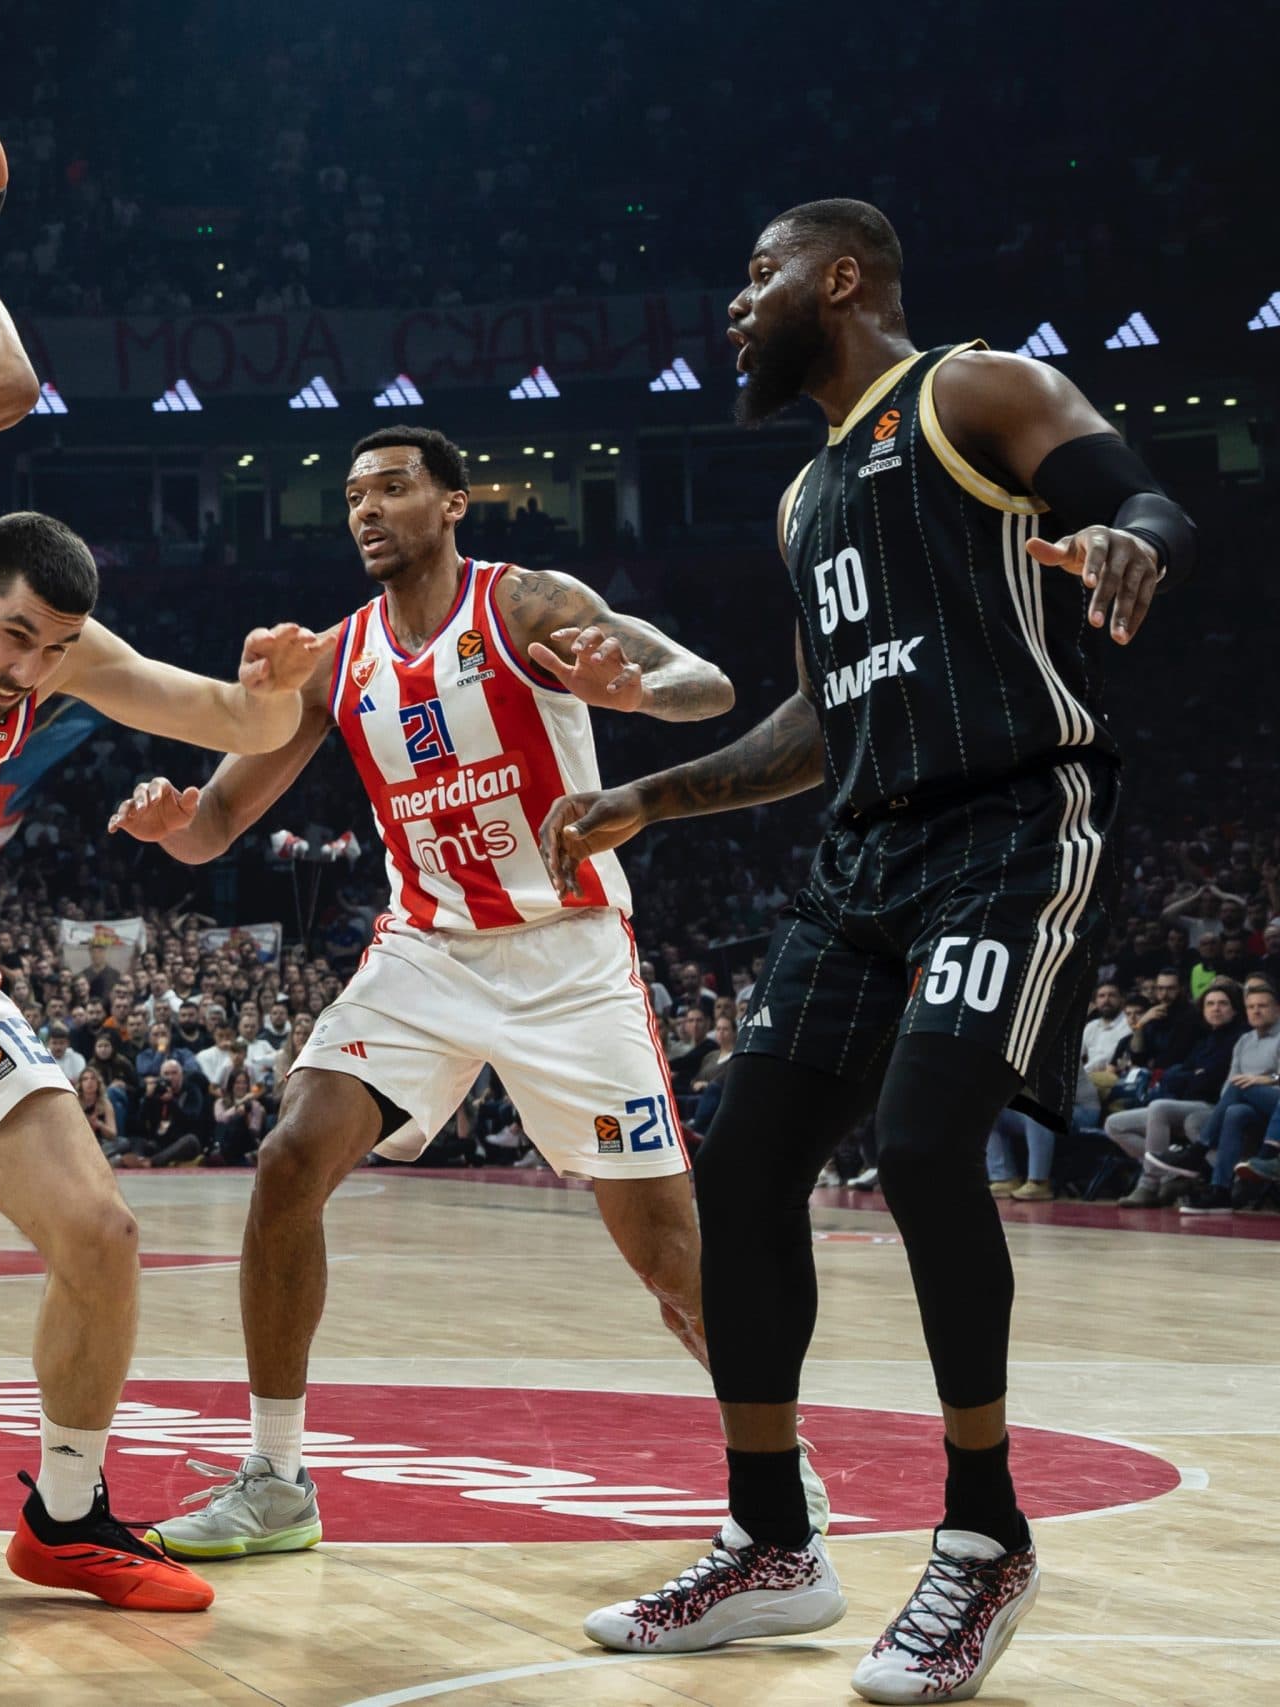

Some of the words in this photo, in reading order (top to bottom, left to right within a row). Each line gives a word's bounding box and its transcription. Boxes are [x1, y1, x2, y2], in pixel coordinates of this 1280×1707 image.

[814, 546, 869, 635] 50
[456, 669, 495, 687] oneteam
[398, 697, 456, 765] 21
[390, 764, 521, 821] meridian
[416, 821, 517, 875] mts
[924, 936, 1010, 1013] 50
[625, 1094, 674, 1152] 21
